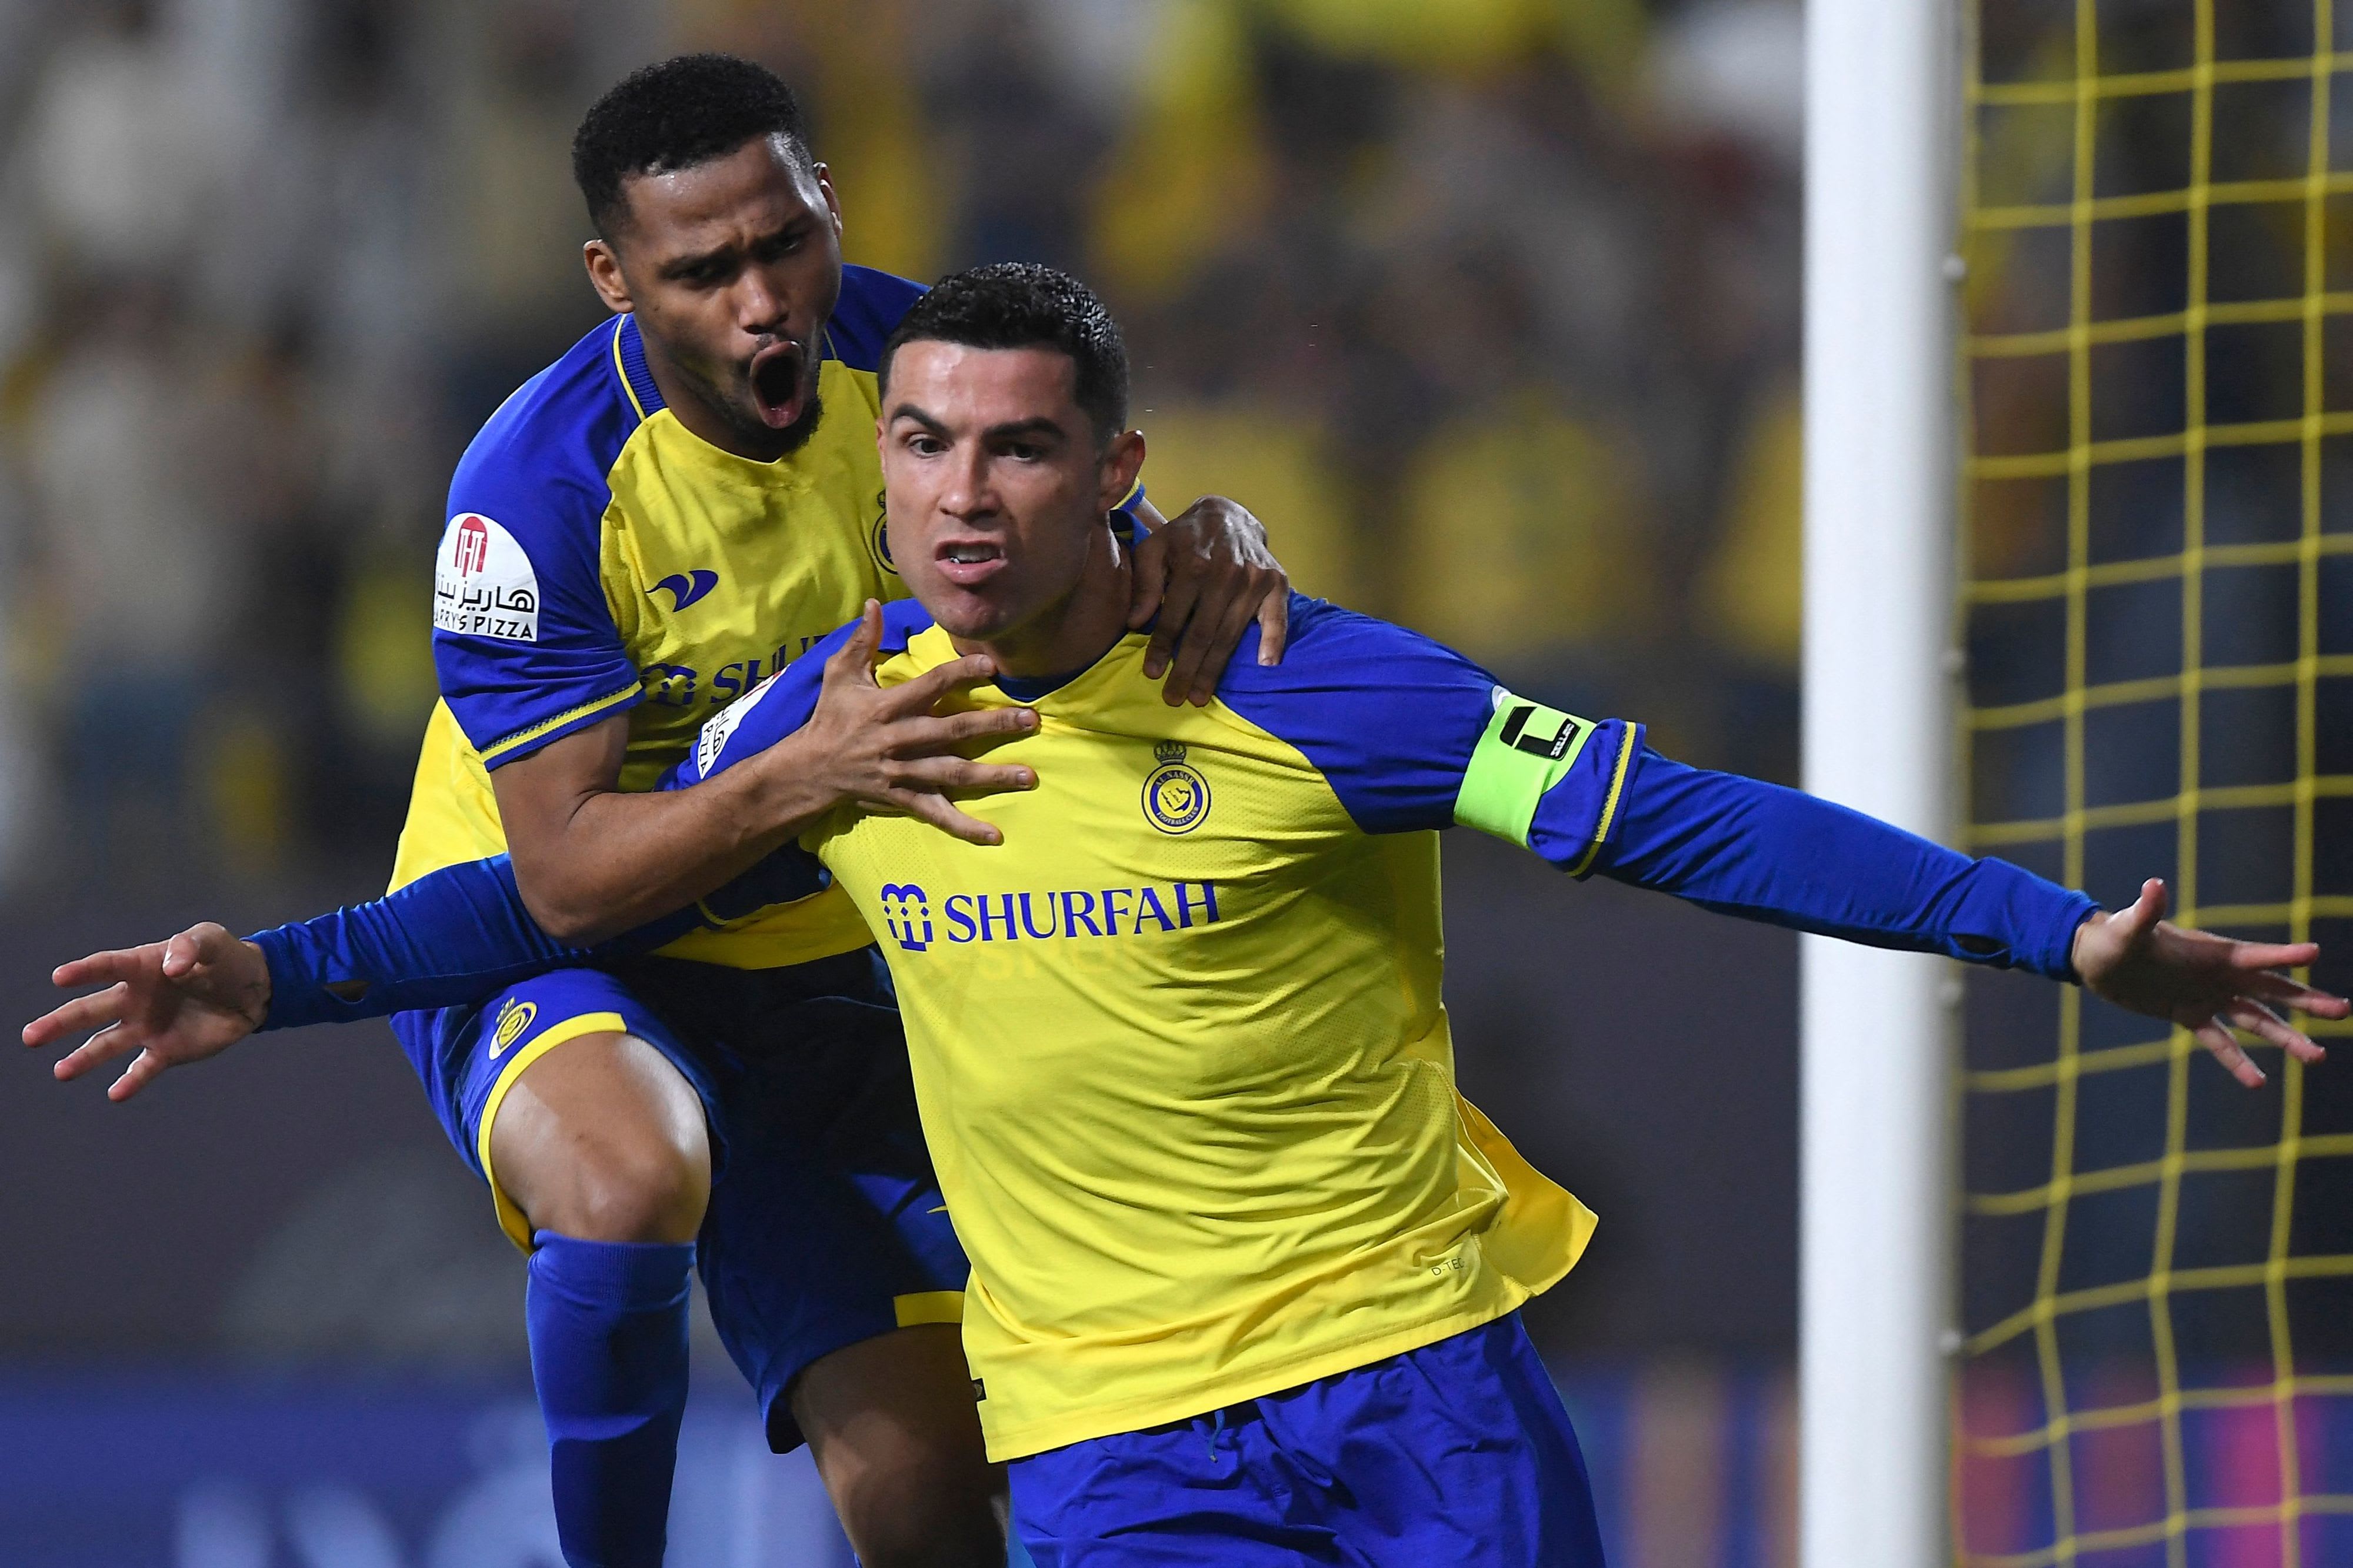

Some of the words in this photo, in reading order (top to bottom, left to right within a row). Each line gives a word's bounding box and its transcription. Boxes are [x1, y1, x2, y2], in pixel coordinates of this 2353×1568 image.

[473, 616, 533, 639] PIZZA
[699, 723, 714, 774] PIZZA
[944, 880, 1221, 943] SHURFAH
